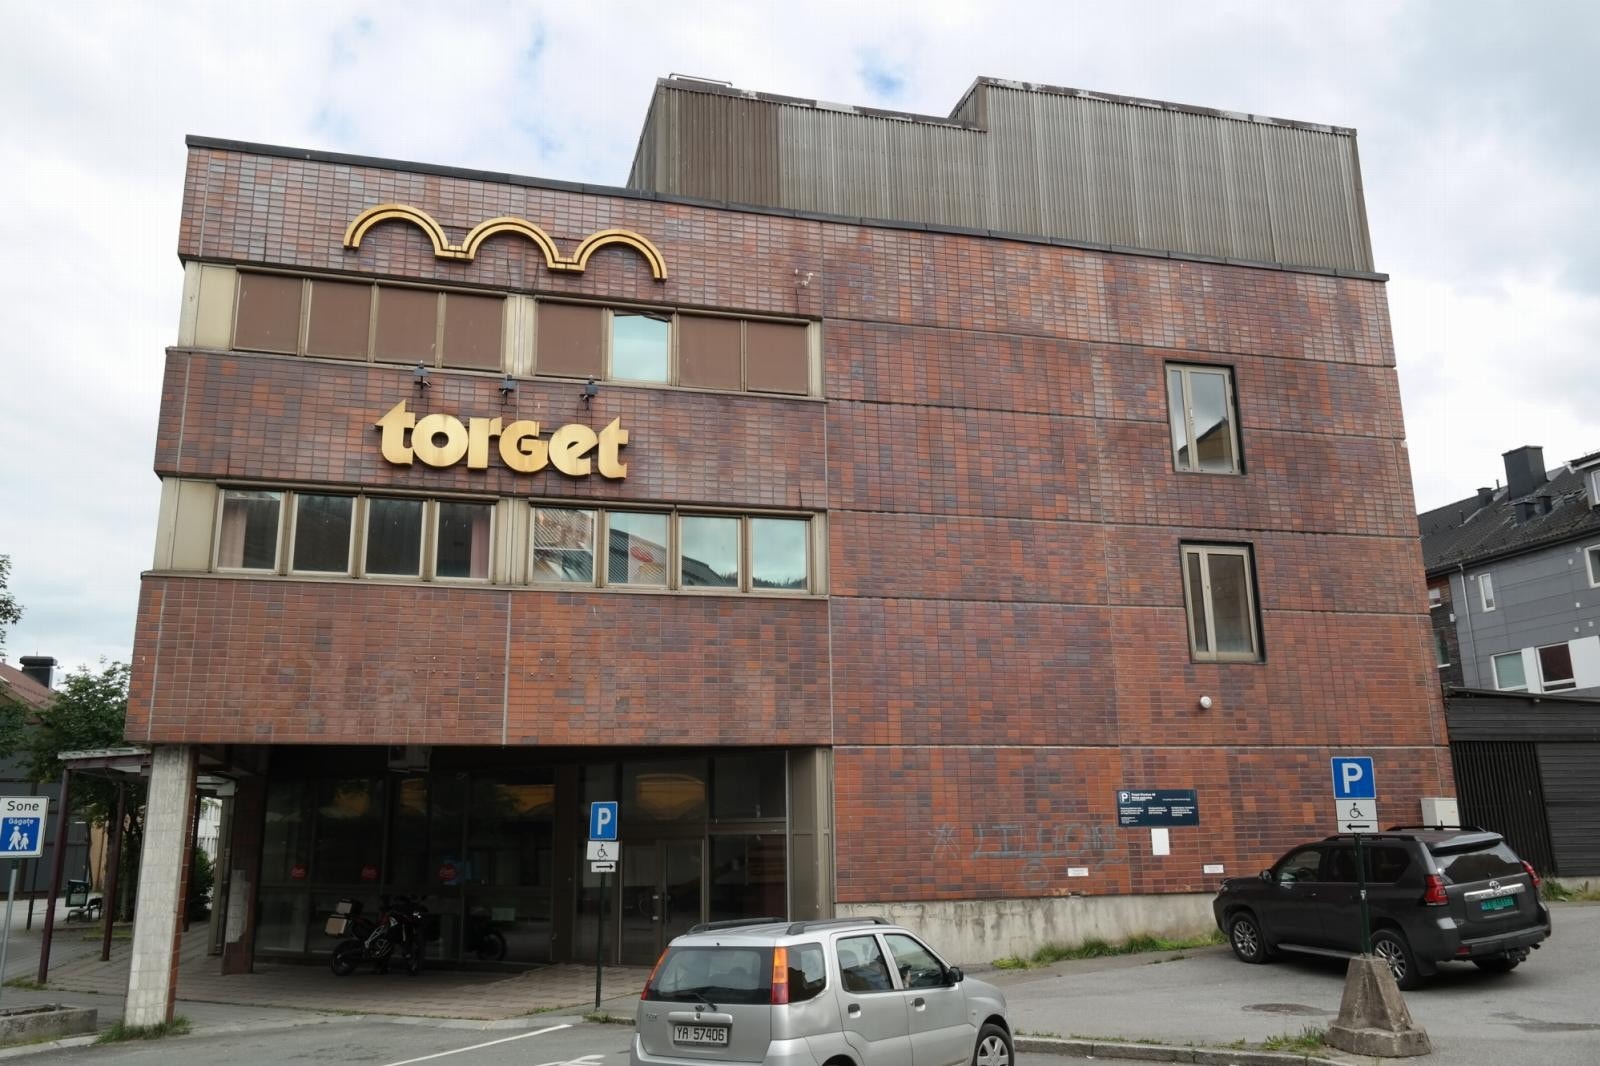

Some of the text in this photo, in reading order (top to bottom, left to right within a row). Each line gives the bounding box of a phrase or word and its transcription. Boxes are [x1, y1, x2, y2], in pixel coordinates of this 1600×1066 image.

[1341, 762, 1363, 793] P
[1121, 793, 1128, 802] P
[7, 800, 40, 811] Sone
[597, 807, 611, 835] P
[677, 1027, 725, 1042] YA 57406
